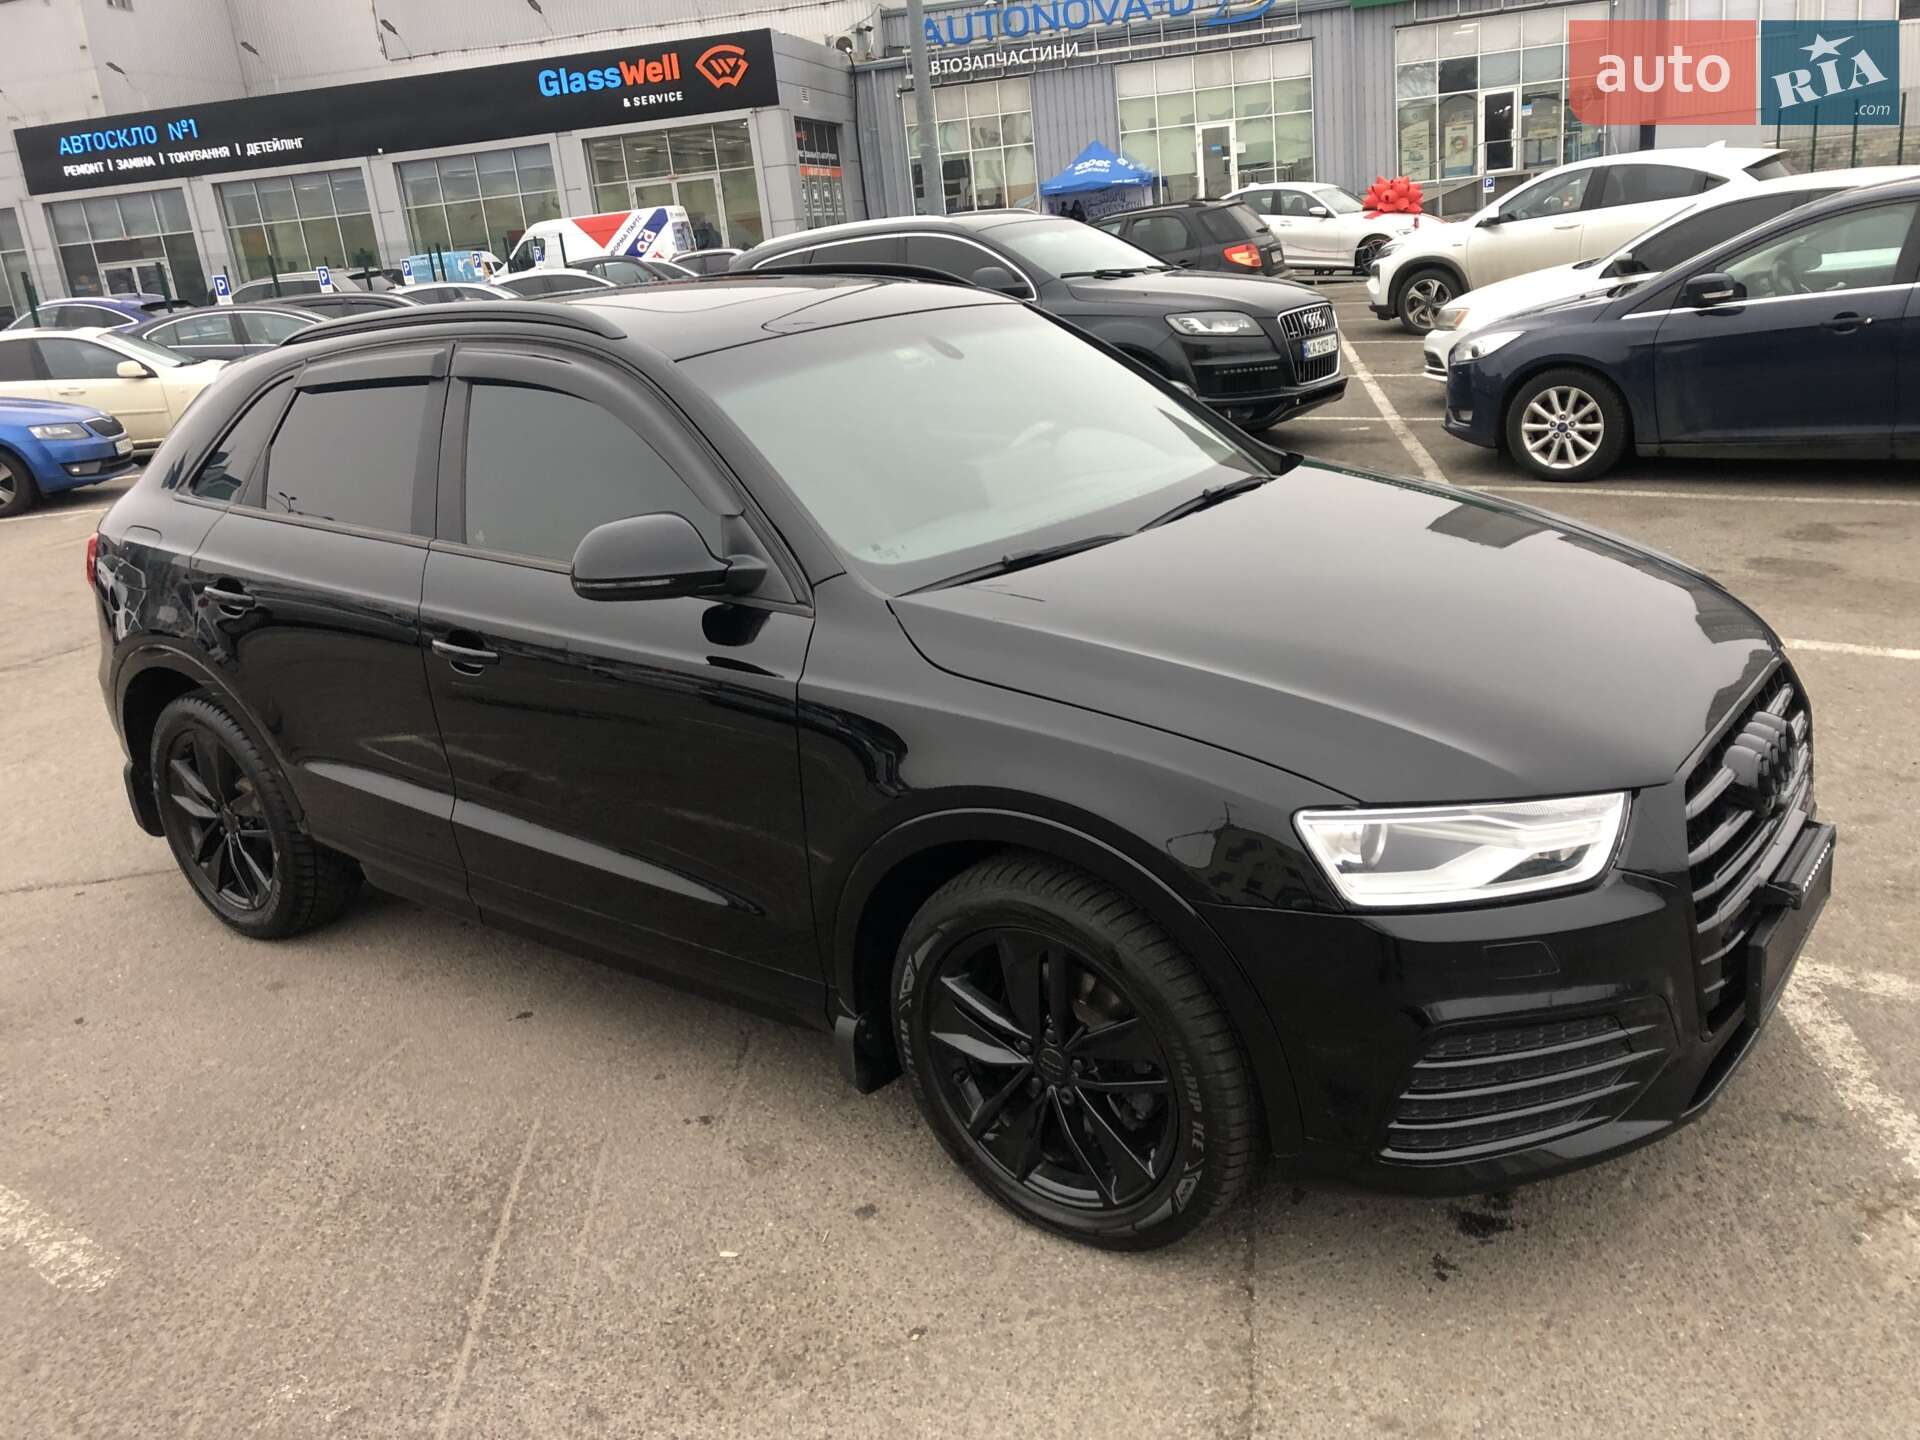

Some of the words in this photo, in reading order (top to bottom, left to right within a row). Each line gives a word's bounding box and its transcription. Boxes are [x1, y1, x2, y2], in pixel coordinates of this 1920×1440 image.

[537, 52, 681, 97] GlassWell
[929, 42, 1079, 76] ВТОЗАПЧАСТИНИ
[633, 91, 684, 106] SERVICE
[59, 125, 158, 155] АВТОСКЛО
[167, 118, 198, 141] №1
[63, 161, 105, 177] РЕМОНТ
[116, 154, 155, 171] ЗАМІНА
[168, 146, 231, 164] ТОНУВАННЯ
[246, 137, 304, 157] ДЕТЕЙЛІНГ
